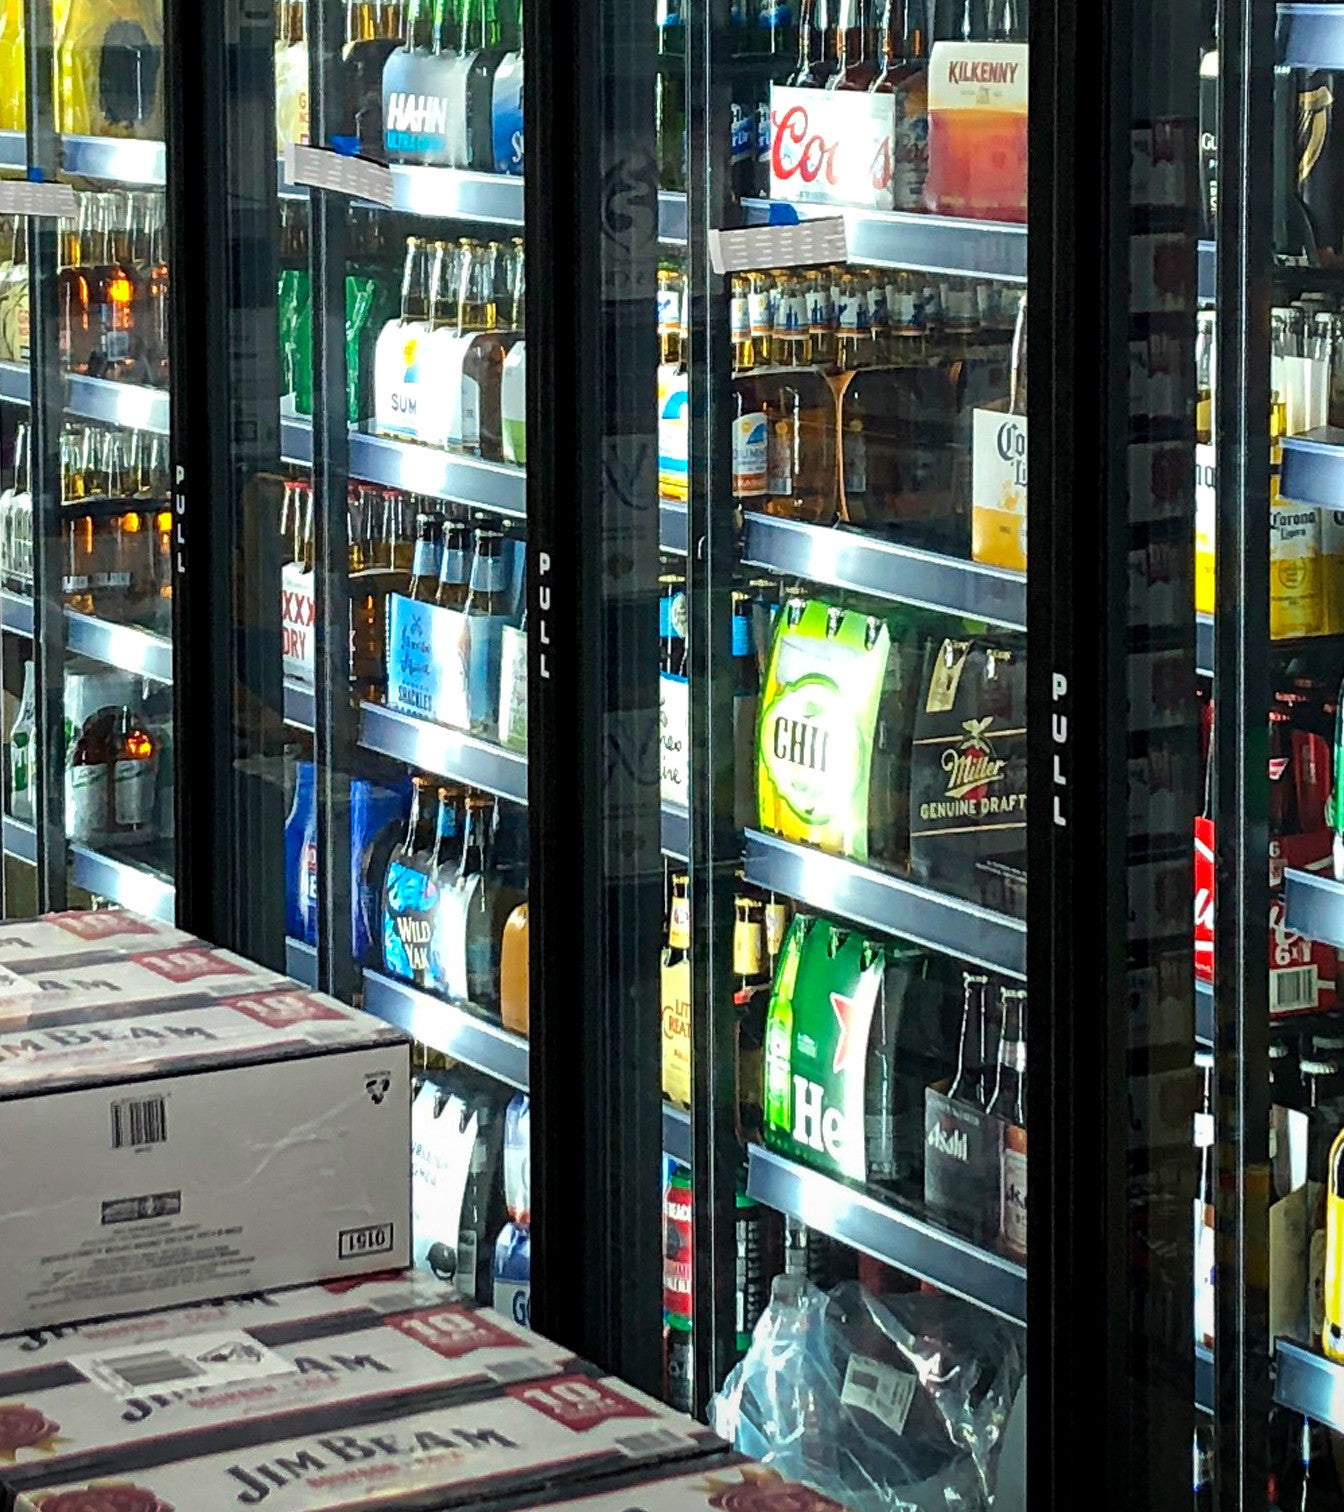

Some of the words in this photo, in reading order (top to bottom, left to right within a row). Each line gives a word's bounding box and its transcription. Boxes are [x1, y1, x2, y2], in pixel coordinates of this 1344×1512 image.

[948, 60, 1019, 87] KILKENNY
[387, 92, 448, 135] HAHN
[176, 464, 186, 574] PULL
[539, 551, 551, 679] PULL
[282, 628, 306, 661] DRY
[398, 684, 433, 712] SHACKLES
[1052, 672, 1068, 827] PULL
[941, 746, 1006, 798] Miller
[920, 797, 977, 820] GENUINE
[980, 793, 1028, 815] DRAFT
[396, 915, 430, 944] WILD
[405, 943, 430, 970] YAK
[47, 1022, 218, 1052] BEAM
[928, 1121, 968, 1162] Asahi
[224, 1449, 327, 1507] JIM
[318, 1425, 519, 1464] BEAM
